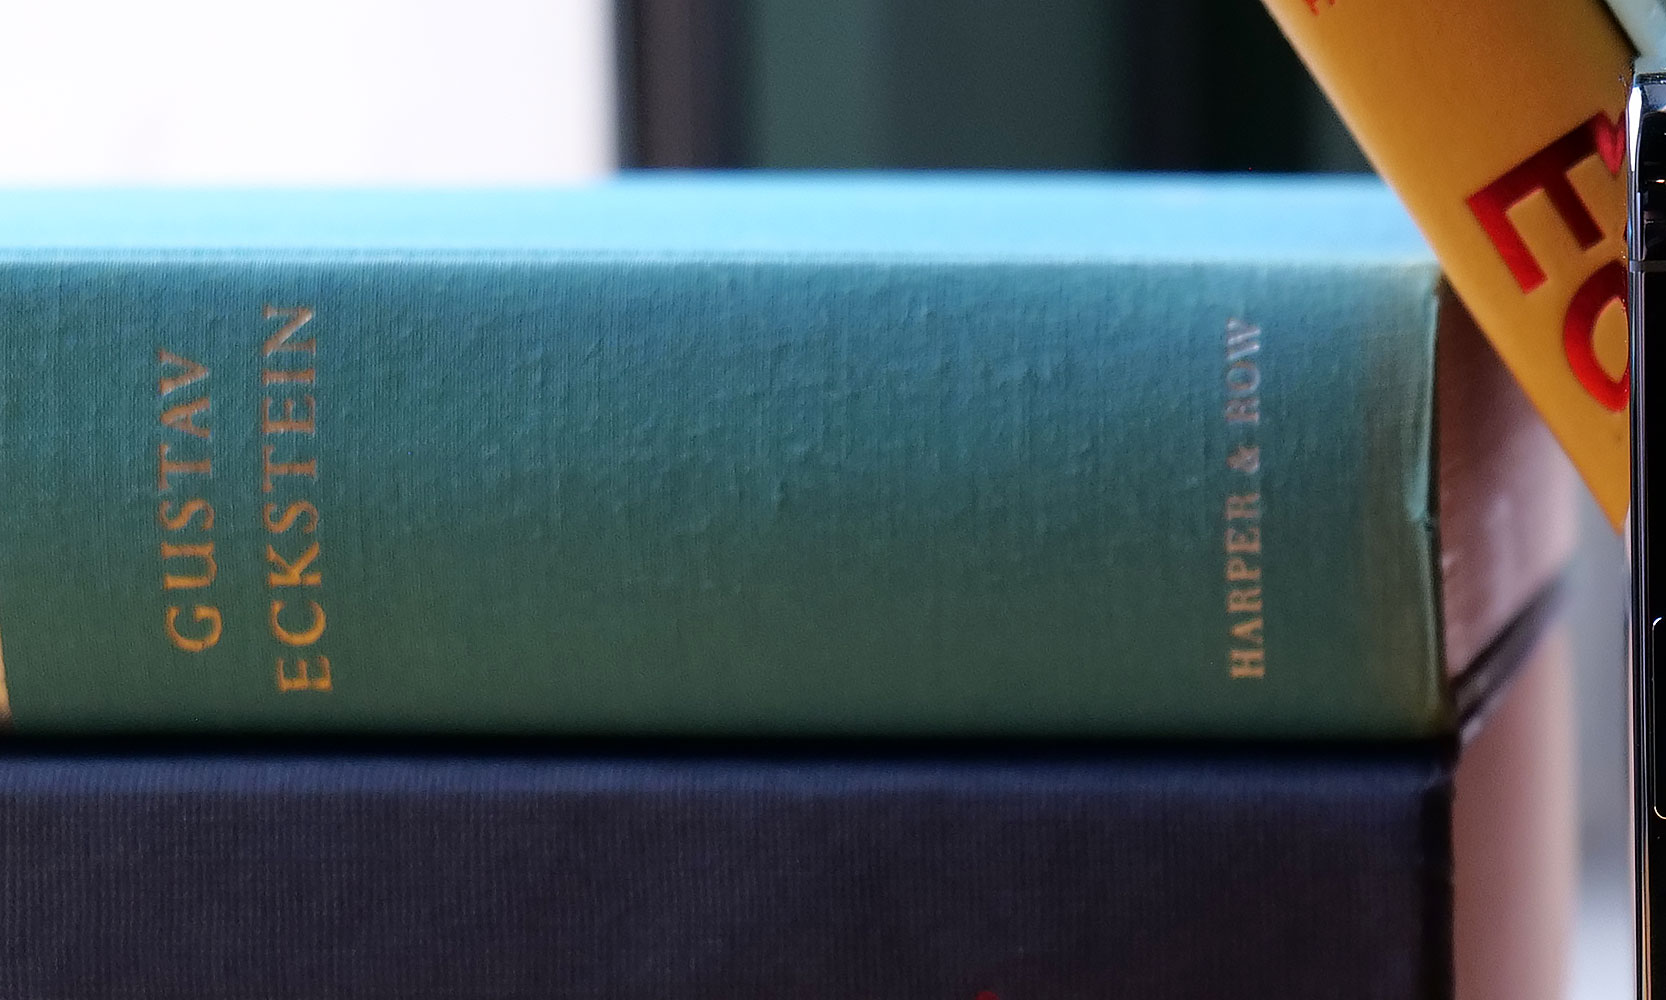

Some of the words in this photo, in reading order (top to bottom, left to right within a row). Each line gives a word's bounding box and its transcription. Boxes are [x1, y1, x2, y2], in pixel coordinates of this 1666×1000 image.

[1226, 317, 1262, 425] ROW
[1227, 445, 1261, 475] &
[156, 346, 223, 653] GUSTAV
[262, 302, 334, 694] ECKSTEIN
[1225, 491, 1266, 679] HARPER
